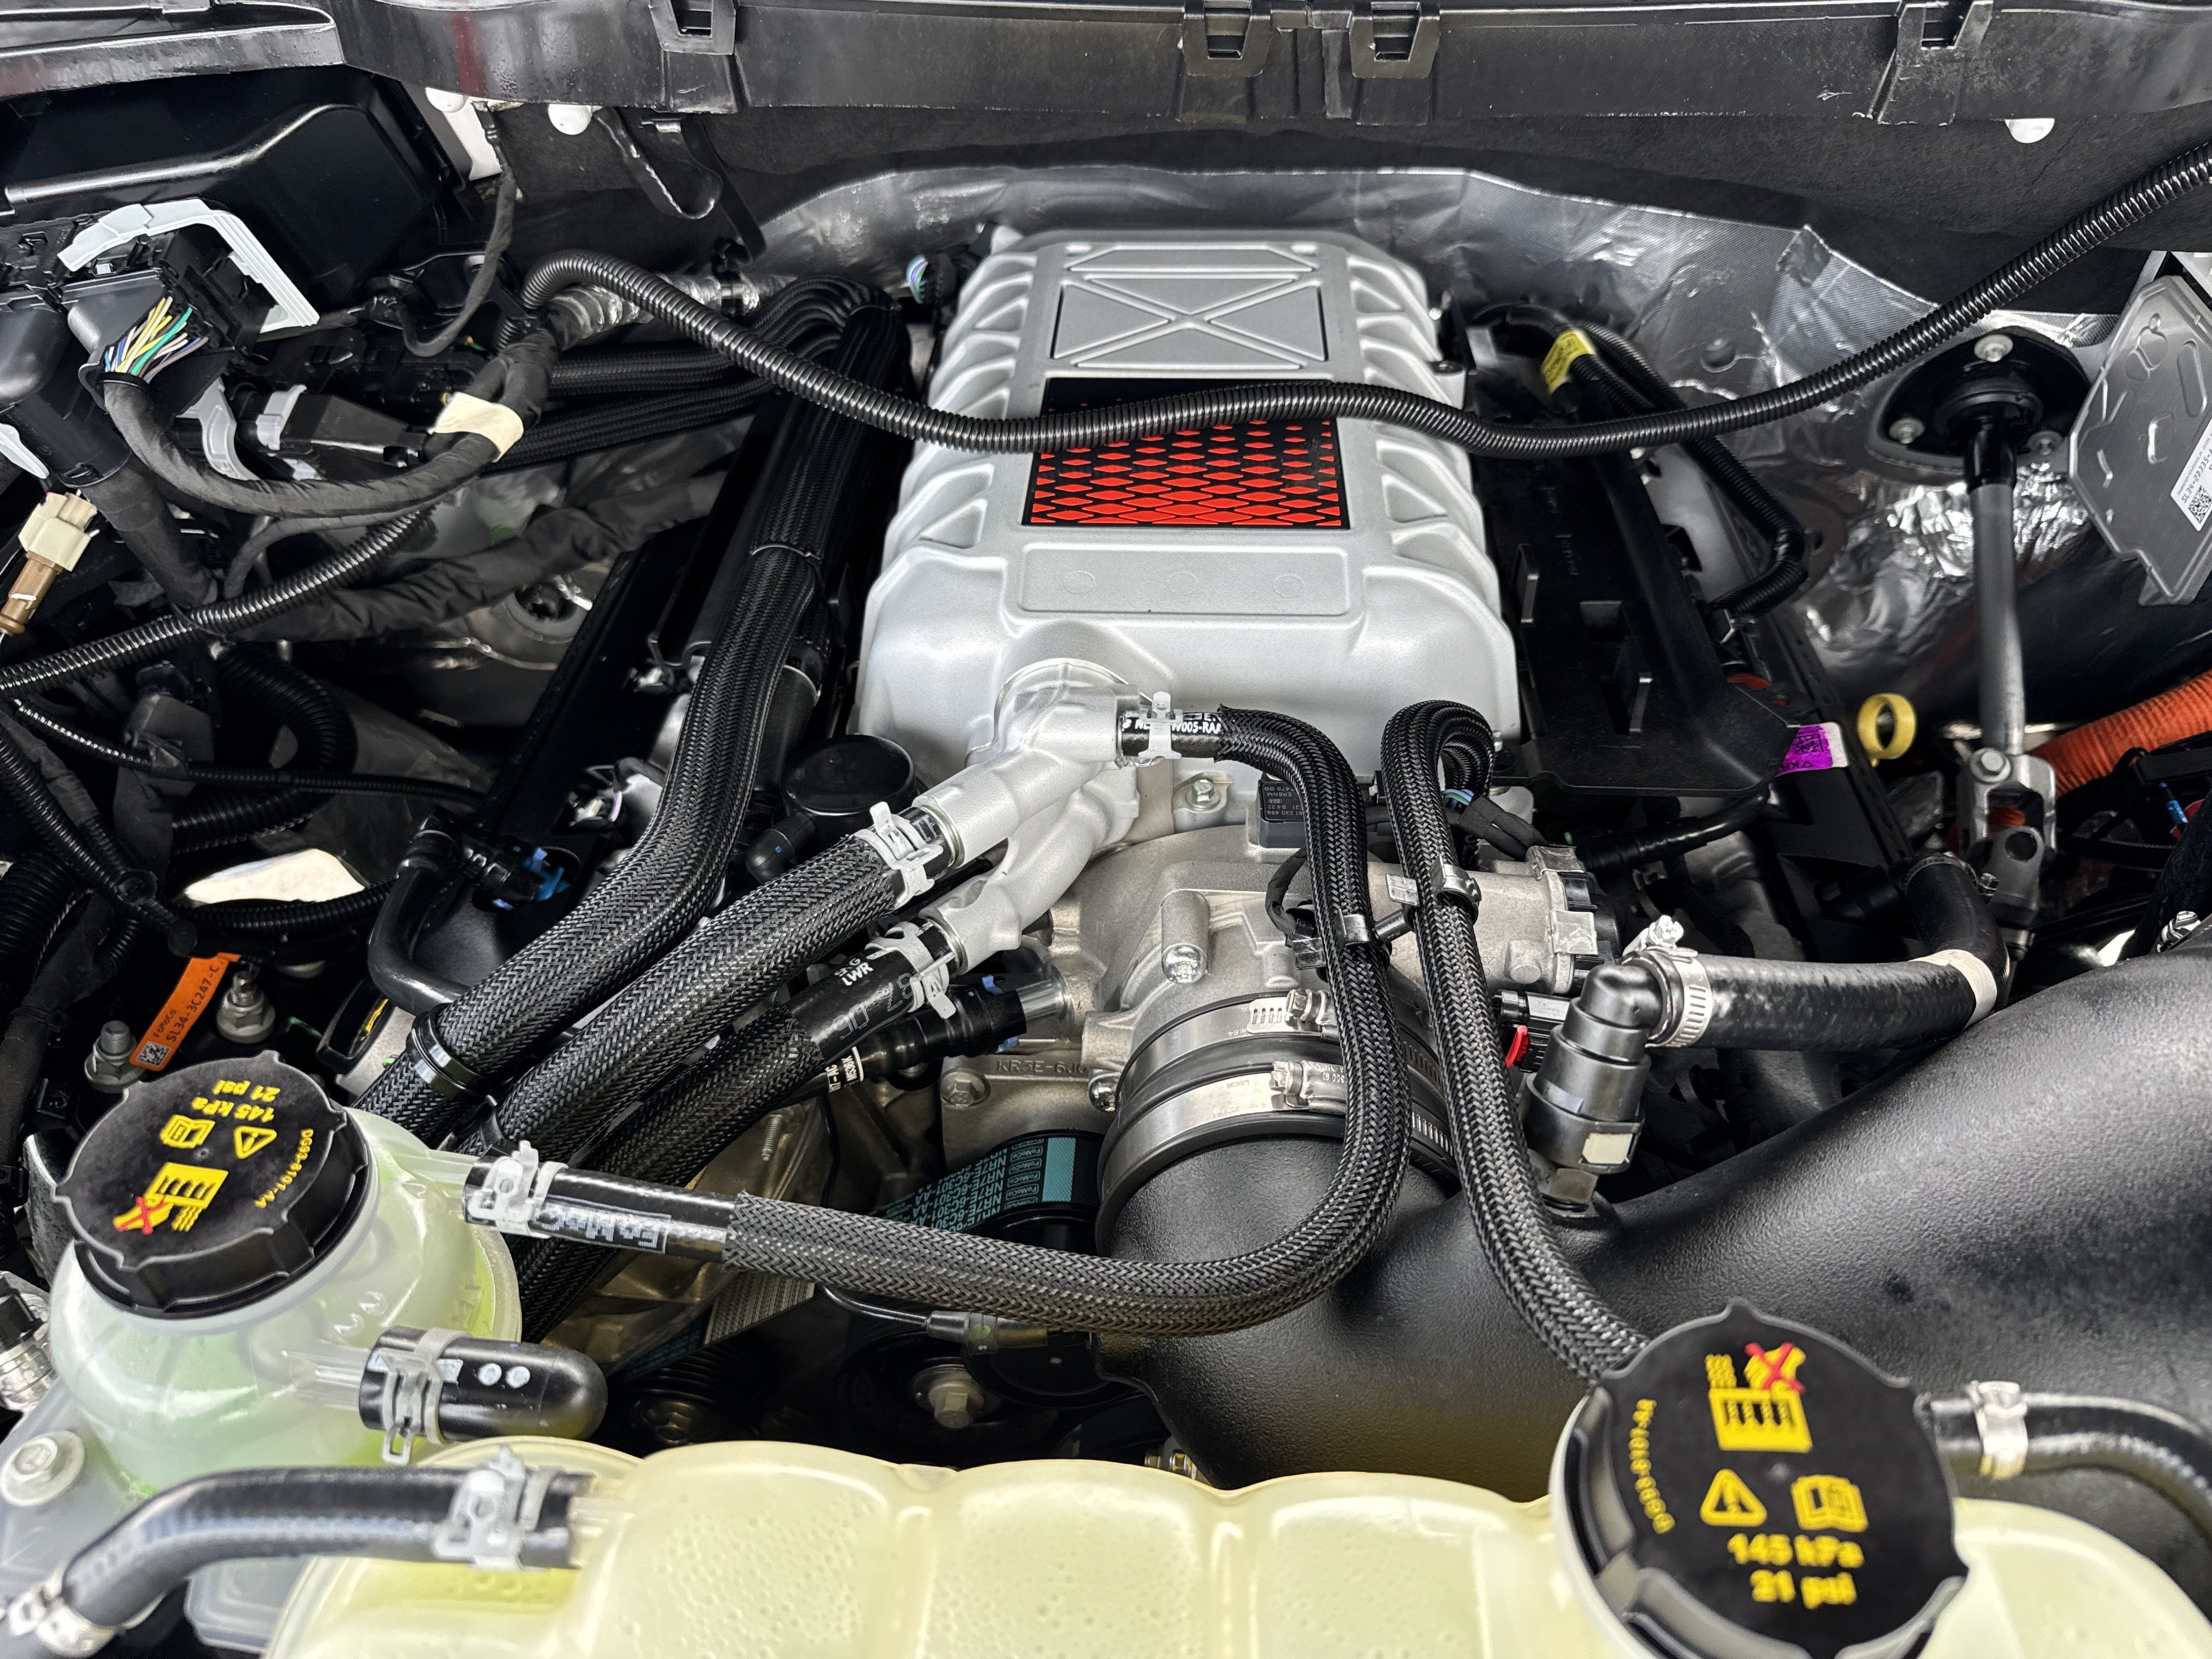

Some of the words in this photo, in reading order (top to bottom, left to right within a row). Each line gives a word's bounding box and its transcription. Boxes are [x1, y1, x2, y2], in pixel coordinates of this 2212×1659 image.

[250, 1085, 280, 1103] 21
[191, 1097, 235, 1118] kPa
[234, 1104, 274, 1123] 145
[253, 1128, 314, 1209] DG93-8101-AA
